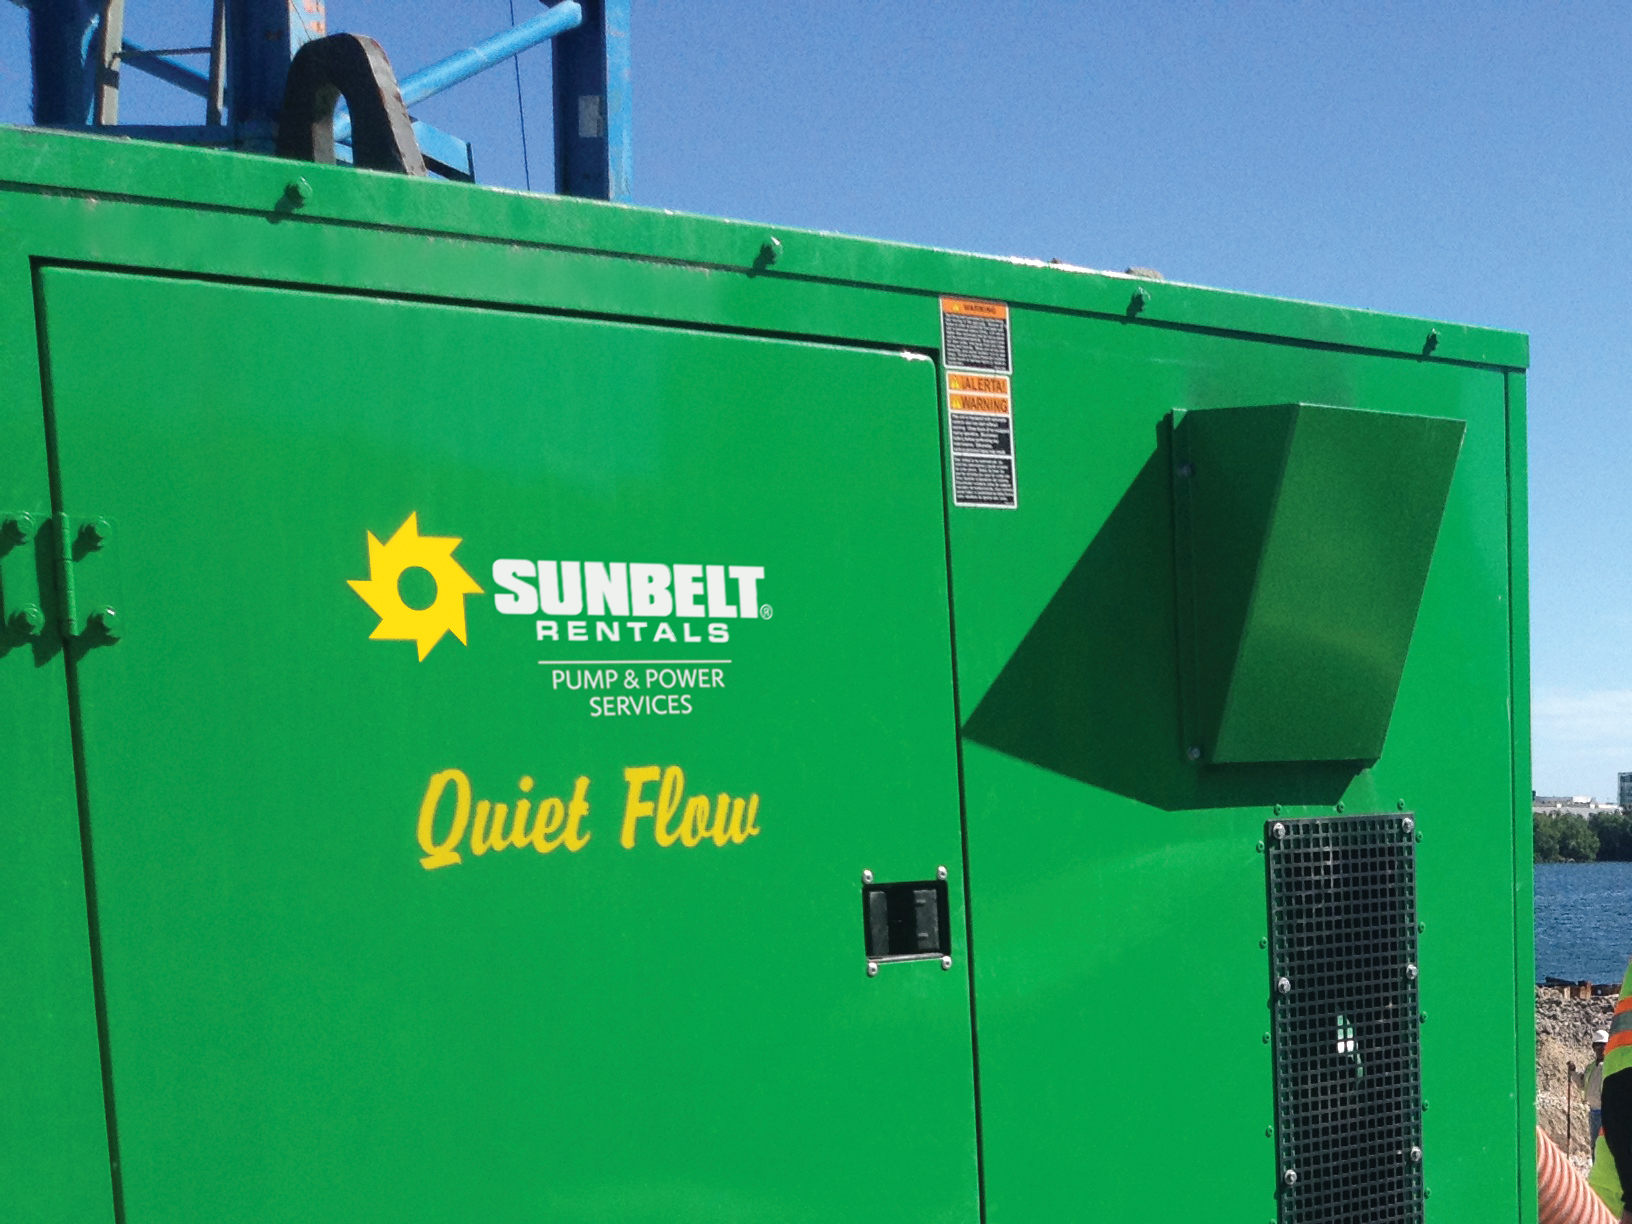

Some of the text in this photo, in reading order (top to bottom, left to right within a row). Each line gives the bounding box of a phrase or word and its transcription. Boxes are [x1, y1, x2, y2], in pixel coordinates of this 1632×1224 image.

[961, 395, 1008, 413] WARNING
[492, 558, 766, 619] SUNBELT
[536, 620, 730, 643] RENTALS
[552, 668, 725, 690] PUMP & POWER
[589, 694, 693, 717] SERVICES
[416, 765, 760, 870] Quiet Flow
